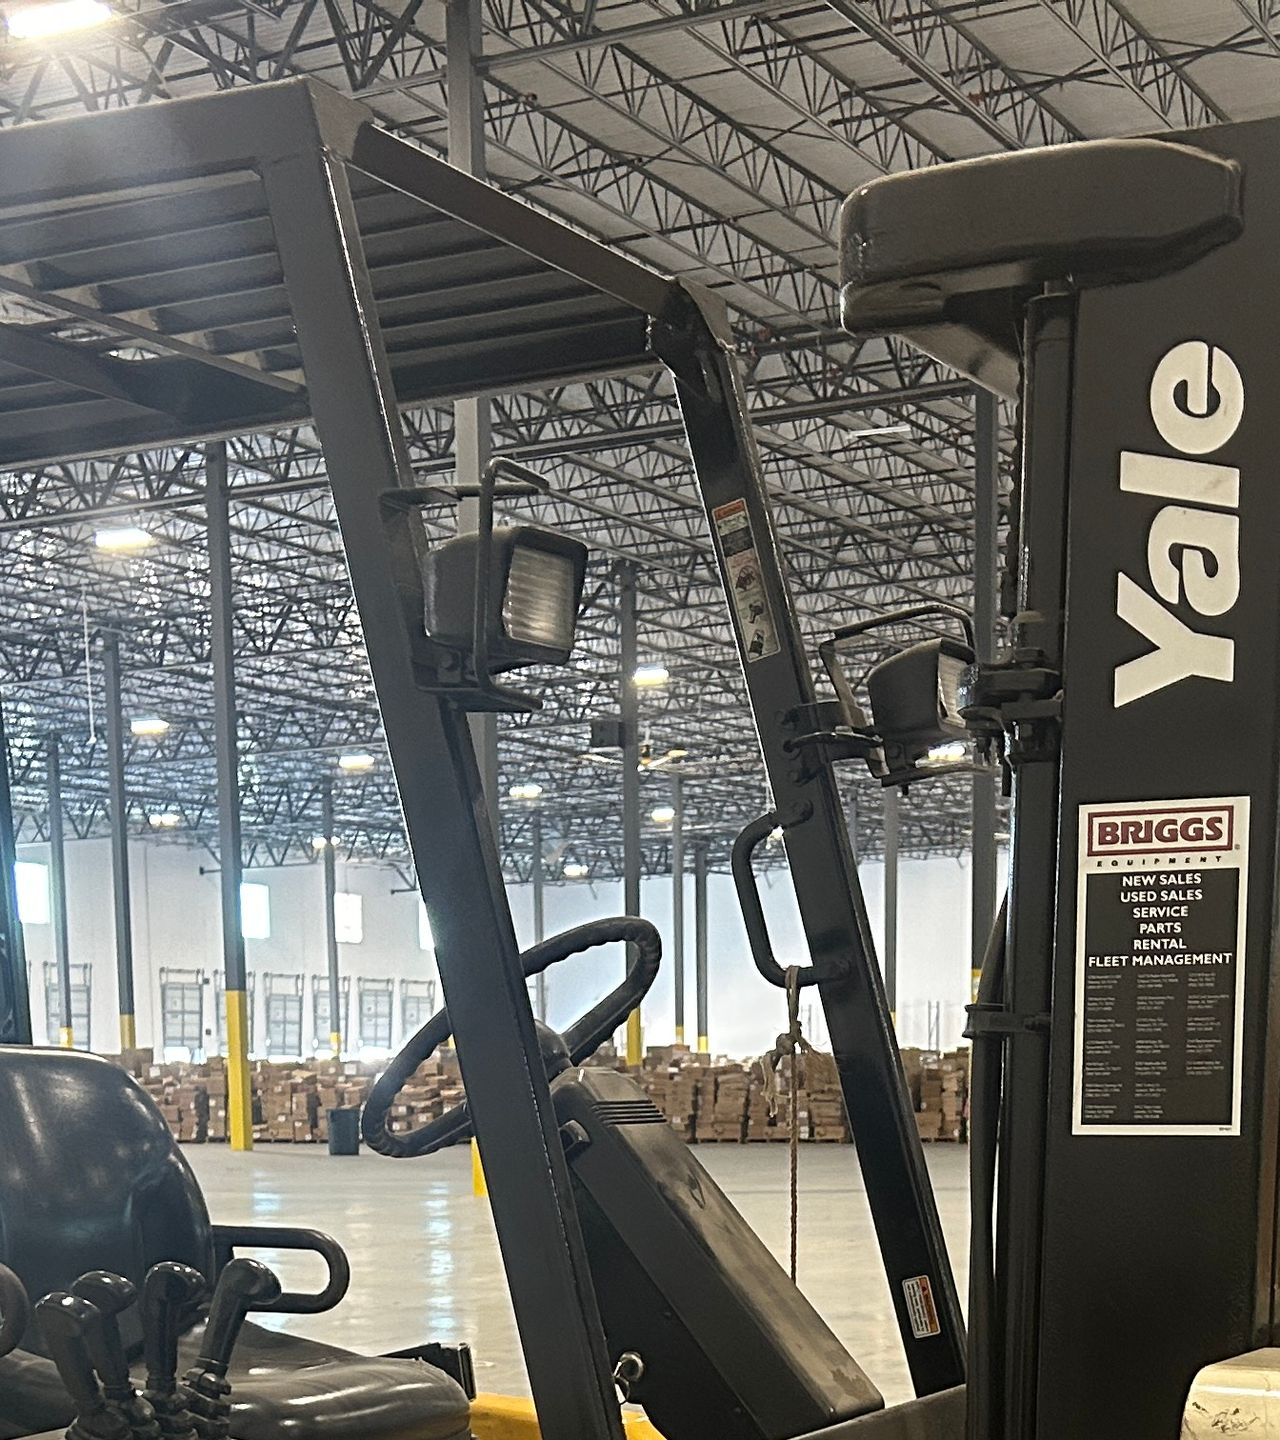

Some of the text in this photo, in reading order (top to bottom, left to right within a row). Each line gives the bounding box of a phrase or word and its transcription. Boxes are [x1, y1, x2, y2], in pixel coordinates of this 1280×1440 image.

[1113, 340, 1245, 709] Yale
[1098, 816, 1223, 846] BRIGGS
[1096, 855, 1223, 868] EQUIPMENT
[1122, 872, 1202, 887] NEW SALES
[1120, 888, 1203, 903] USED SALES
[1132, 905, 1189, 919] SERVICE
[1139, 921, 1182, 934] PARTS
[1133, 937, 1187, 951] RENTAL
[1087, 951, 1233, 968] FLEET MANAGEMENT
